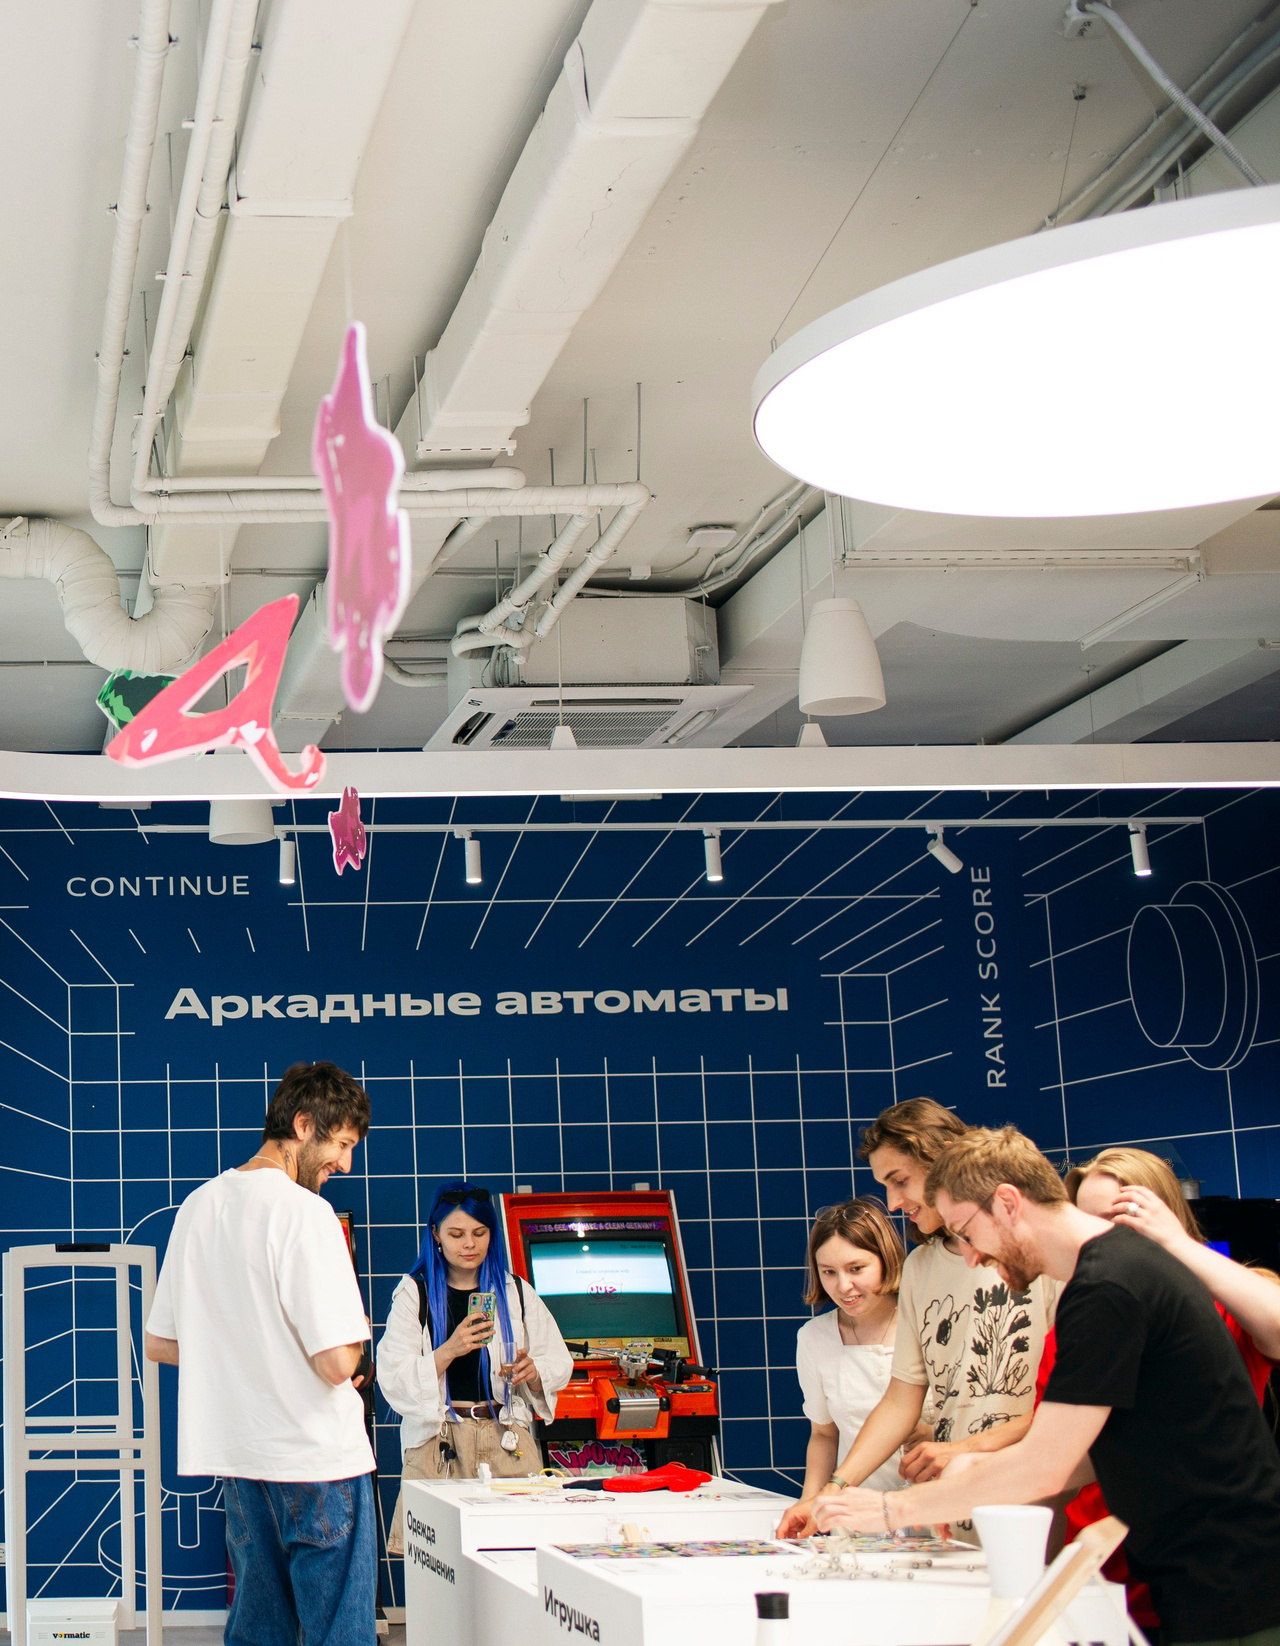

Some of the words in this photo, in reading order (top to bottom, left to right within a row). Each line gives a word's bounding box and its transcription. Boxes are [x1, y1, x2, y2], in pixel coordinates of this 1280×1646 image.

[66, 875, 250, 897] CONTINUE
[970, 865, 999, 980] SCORE
[164, 986, 482, 1026] Аркадные
[495, 987, 789, 1015] автоматы
[980, 992, 1008, 1088] RANK
[407, 1509, 436, 1546] Одежда
[408, 1541, 413, 1558] и
[413, 1545, 455, 1585] украшения
[544, 1585, 600, 1643] Игрушка
